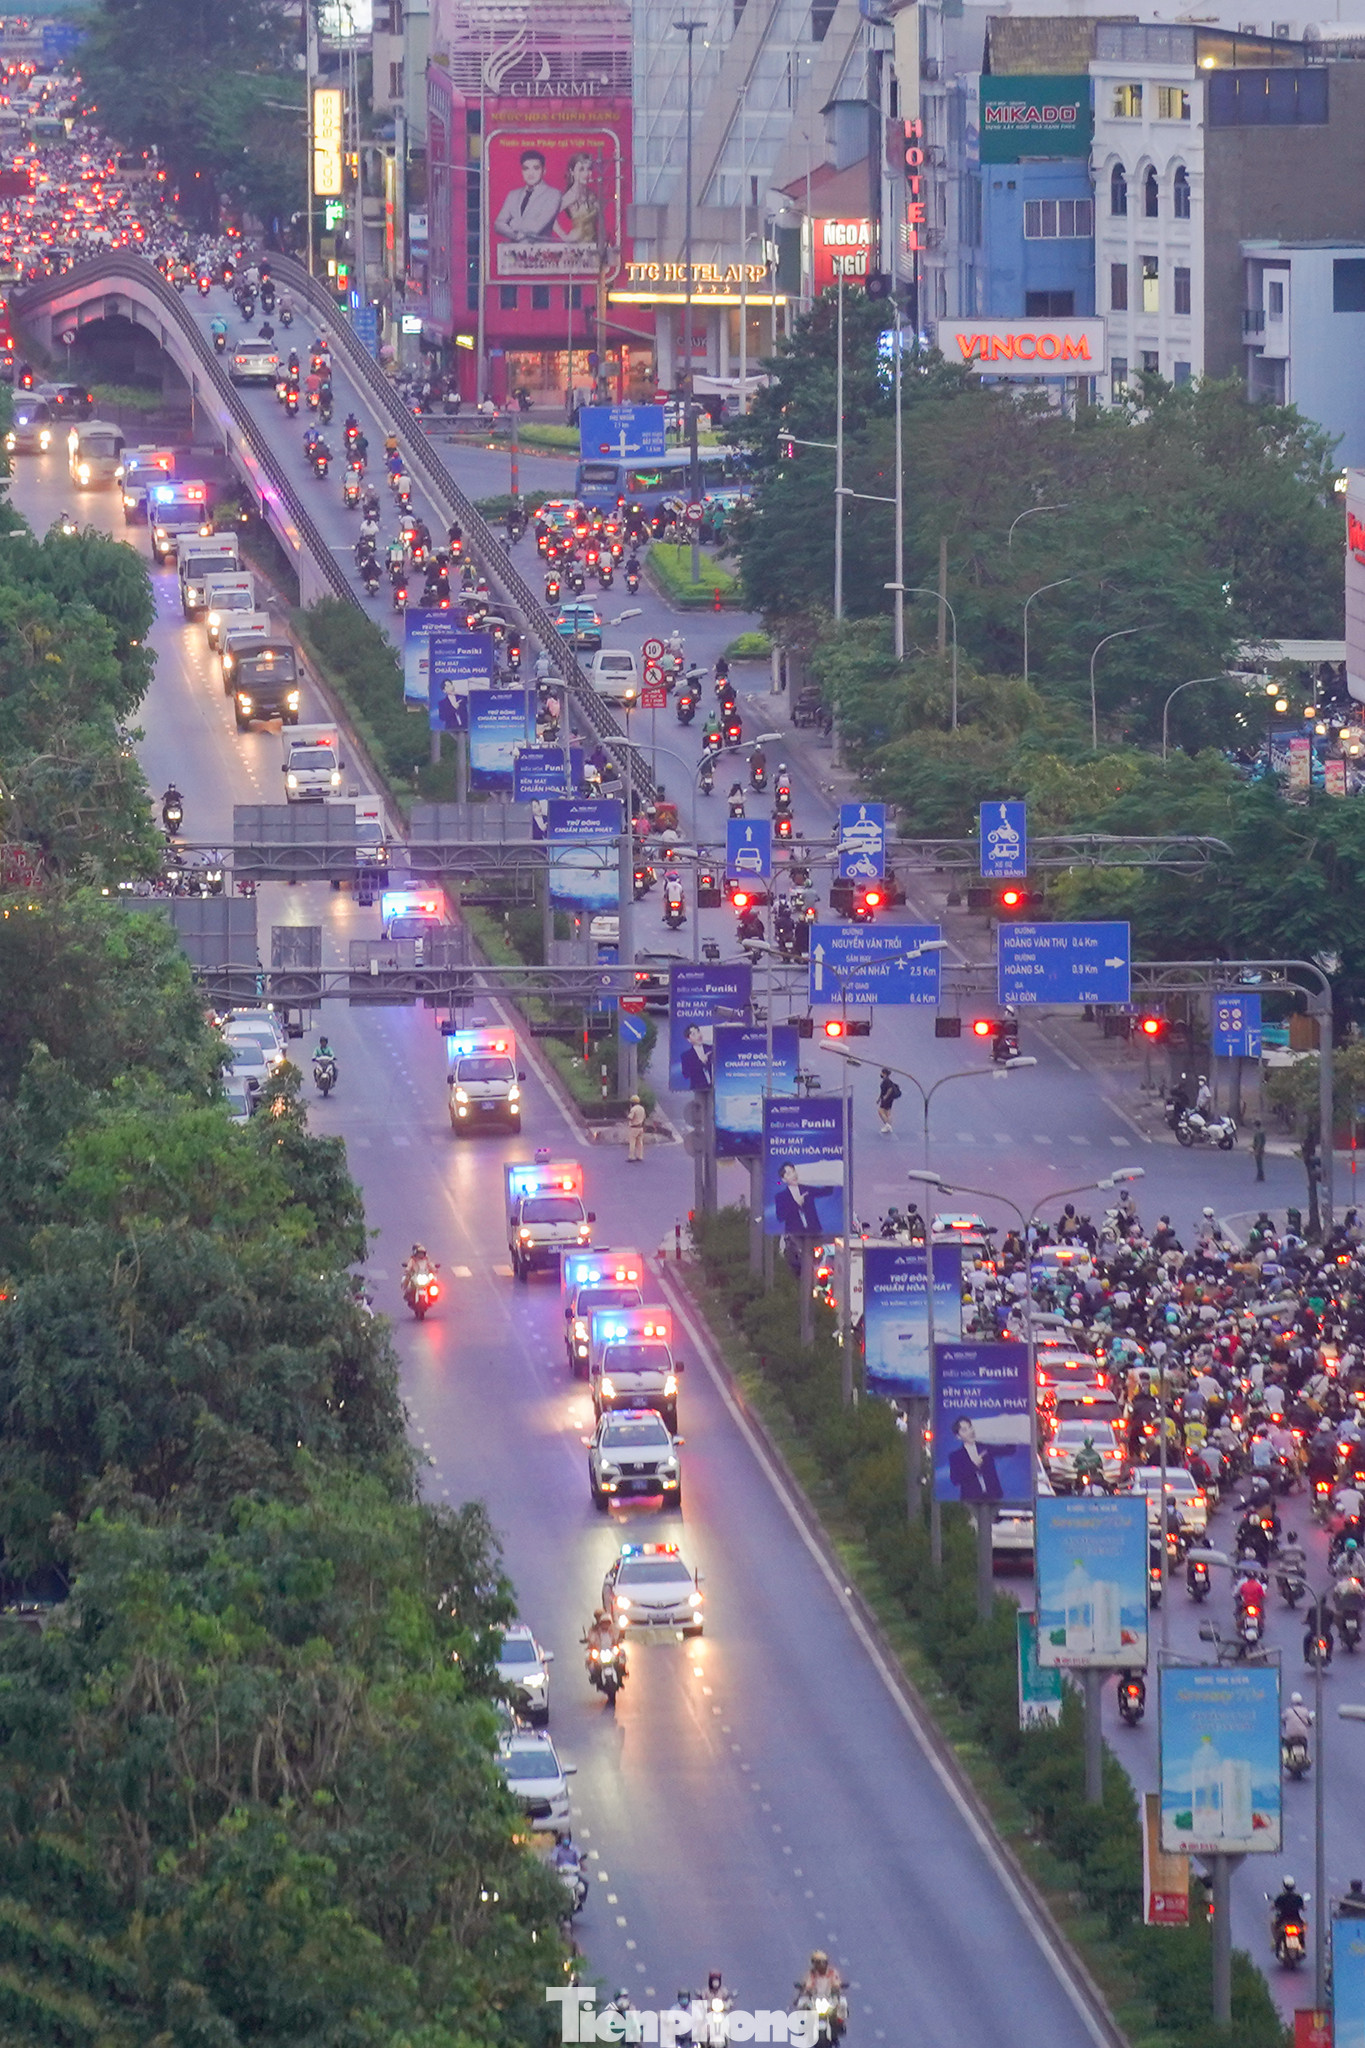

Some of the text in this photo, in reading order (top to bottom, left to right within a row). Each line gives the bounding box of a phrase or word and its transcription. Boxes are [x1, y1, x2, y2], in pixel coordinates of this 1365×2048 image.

[510, 81, 602, 97] CHARME
[985, 106, 1076, 123] MIKADO
[322, 96, 333, 188] GOLF BOSS
[904, 119, 926, 250] HOTEL
[823, 223, 870, 248] NGOẠ
[832, 250, 867, 276] NGỮ
[625, 263, 660, 281] TTG
[663, 263, 722, 282] HOTEL
[955, 333, 1092, 361] VINCOM
[567, 819, 580, 827] TRỮ
[832, 938, 863, 949] NGUYỄN
[865, 938, 884, 949] VĂN
[1004, 937, 1033, 948] HOÀNG
[1033, 936, 1050, 947] VĂN
[1052, 938, 1067, 949] THỤ
[1084, 937, 1098, 947] Km
[867, 962, 891, 975] NHẤT
[923, 967, 936, 976] Km
[1004, 964, 1033, 974] HOÀNG
[1034, 965, 1045, 974] SA
[1084, 965, 1098, 974] Km
[705, 984, 737, 993] Funiki
[831, 992, 853, 1003] HÀNG
[855, 993, 878, 1003] XANH
[923, 994, 936, 1002] Km
[1005, 991, 1098, 1001] SÀI GÒN 4 Km
[676, 1000, 708, 1008] BỀN MÁT
[676, 1009, 705, 1017] CHUẨN
[738, 1052, 752, 1060] TRỮ
[725, 1060, 750, 1068] CHUẨN
[801, 1119, 836, 1128] Funiki
[770, 1136, 804, 1145] BỀN MÁT
[770, 1145, 843, 1155] CHUẨN HÒA PHÁT
[890, 1273, 908, 1282] TRỮ
[873, 1283, 905, 1292] CHUẨN
[906, 1283, 926, 1292] HÒA
[979, 1367, 1018, 1377] Funiki
[943, 1386, 981, 1396] BỀN MÁT
[943, 1398, 1028, 1409] CHUẨN HÒA PHÁT
